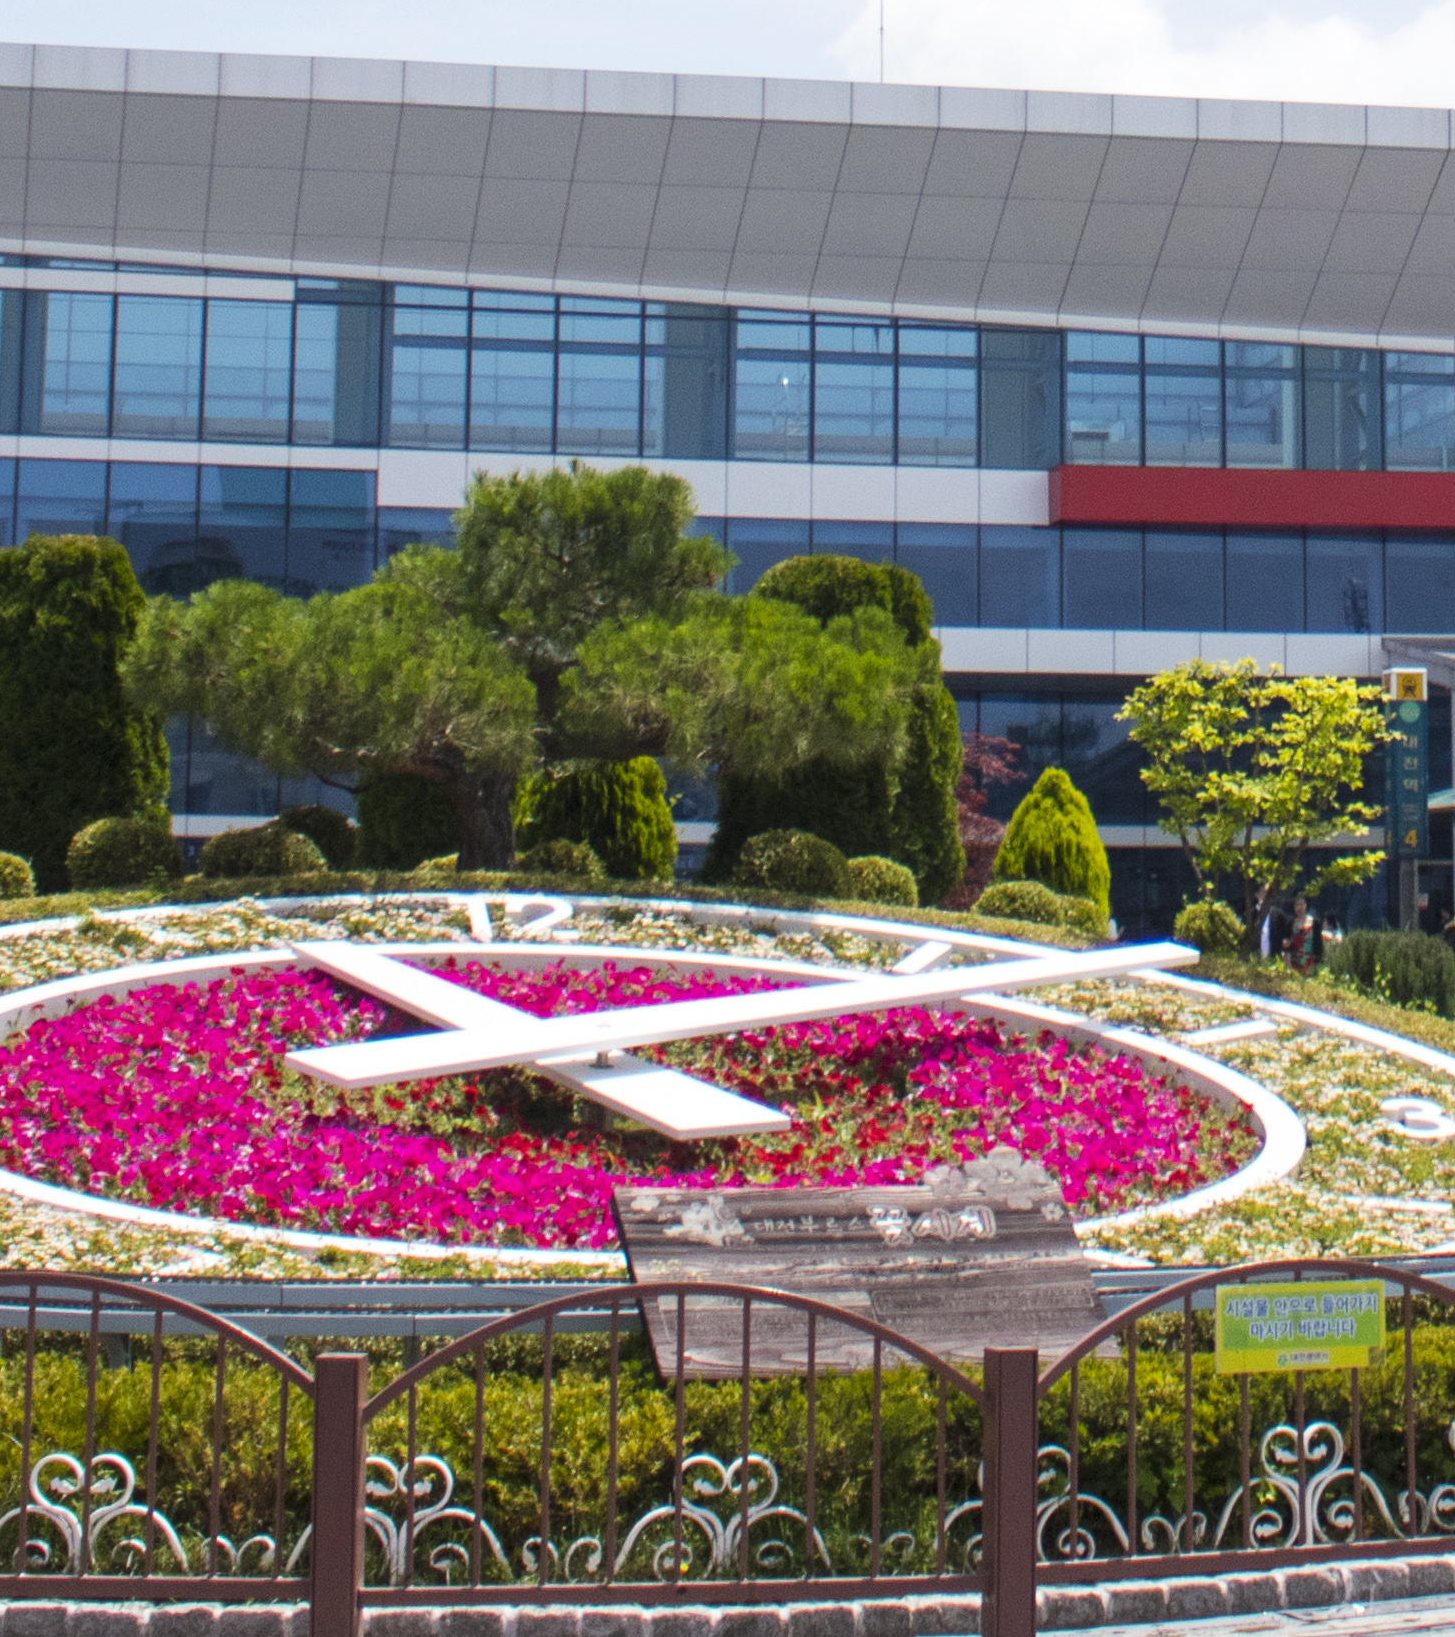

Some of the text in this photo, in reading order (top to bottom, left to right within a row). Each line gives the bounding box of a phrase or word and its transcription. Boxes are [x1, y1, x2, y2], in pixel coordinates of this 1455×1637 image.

[1404, 829, 1418, 848] 4
[468, 896, 581, 941] 12
[1226, 1293, 1378, 1319] 시설물 안으로 들어가지
[1249, 1317, 1356, 1342] 마시기 바랍니다
